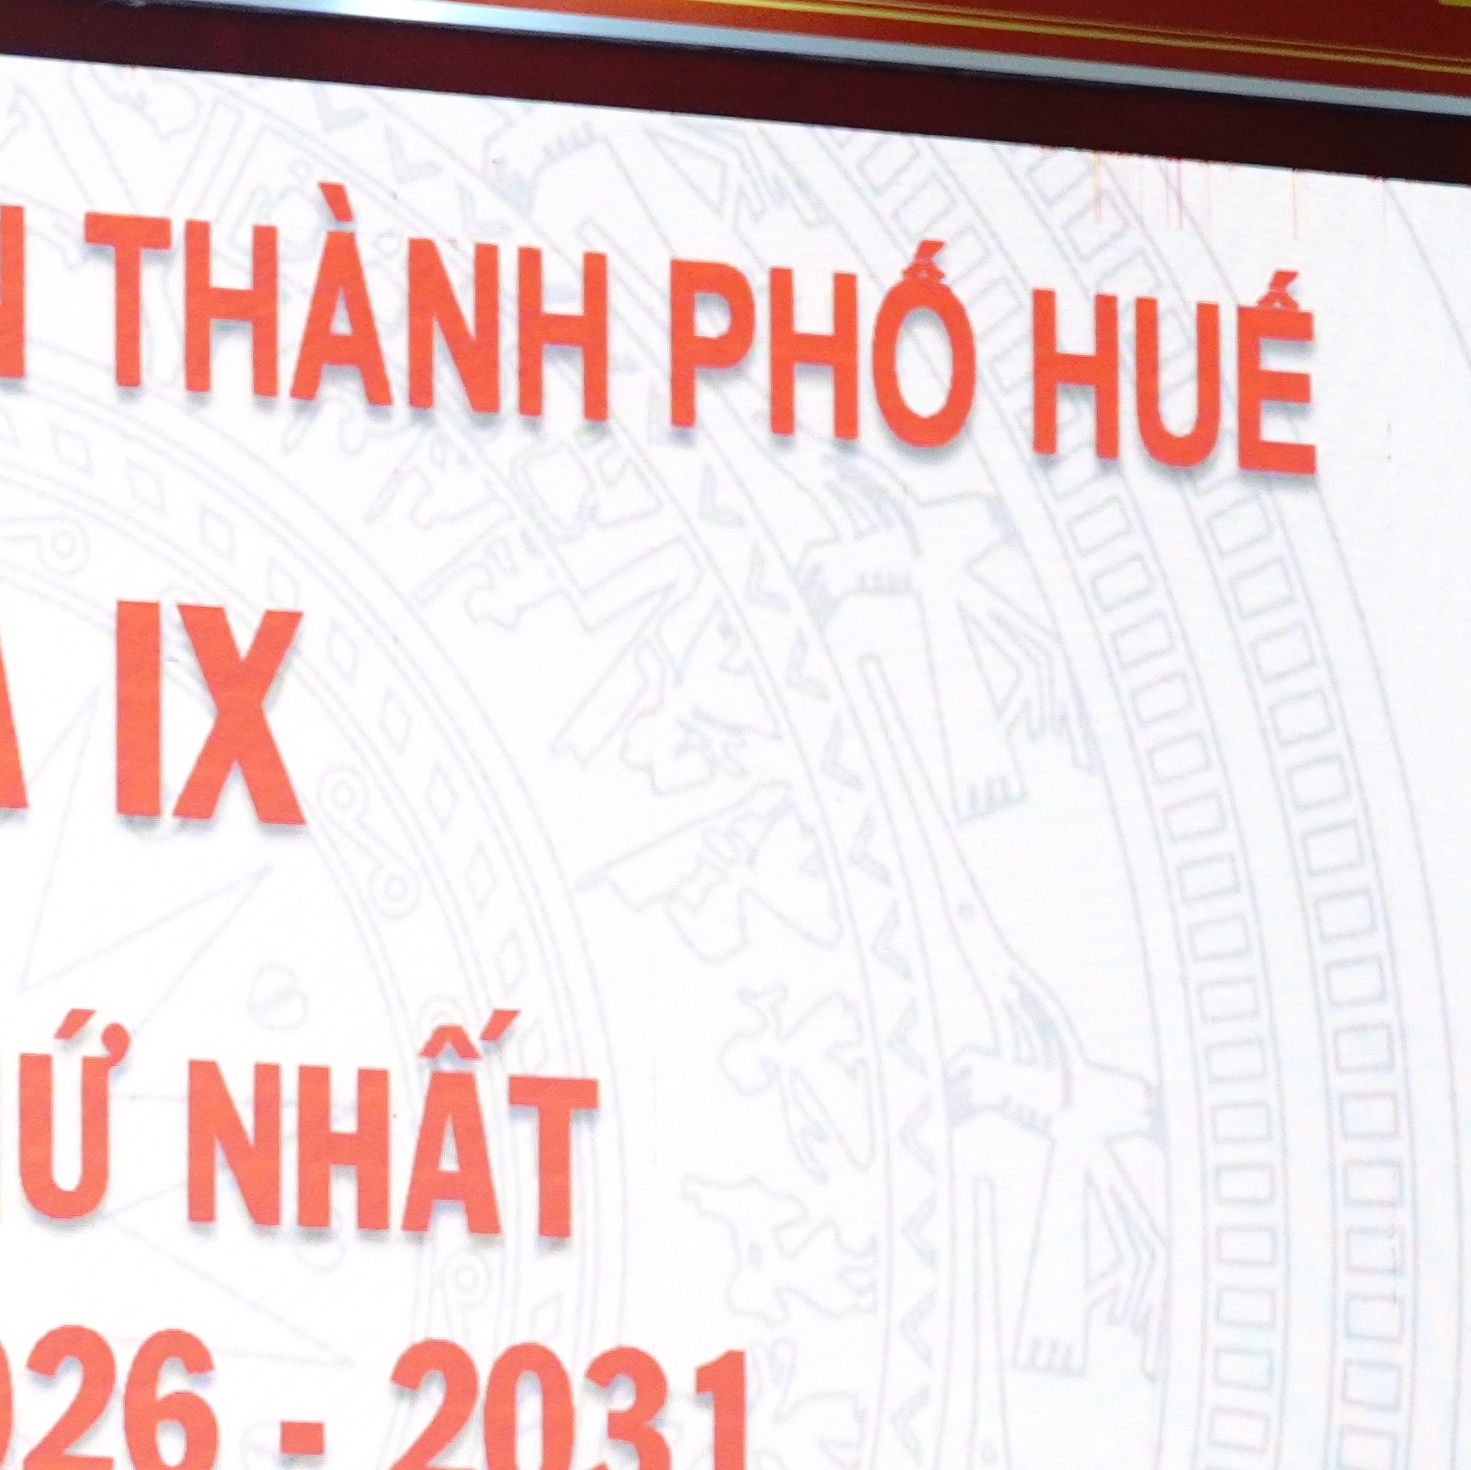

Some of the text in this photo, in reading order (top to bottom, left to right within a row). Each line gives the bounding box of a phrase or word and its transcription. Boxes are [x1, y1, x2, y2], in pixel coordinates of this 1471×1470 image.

[83, 182, 609, 422] THÀNH
[669, 239, 977, 448] PHỐ
[1032, 268, 1318, 476] HUẾ
[116, 600, 306, 826] IX
[187, 1008, 599, 1239] NHẤT
[280, 1421, 325, 1456] -
